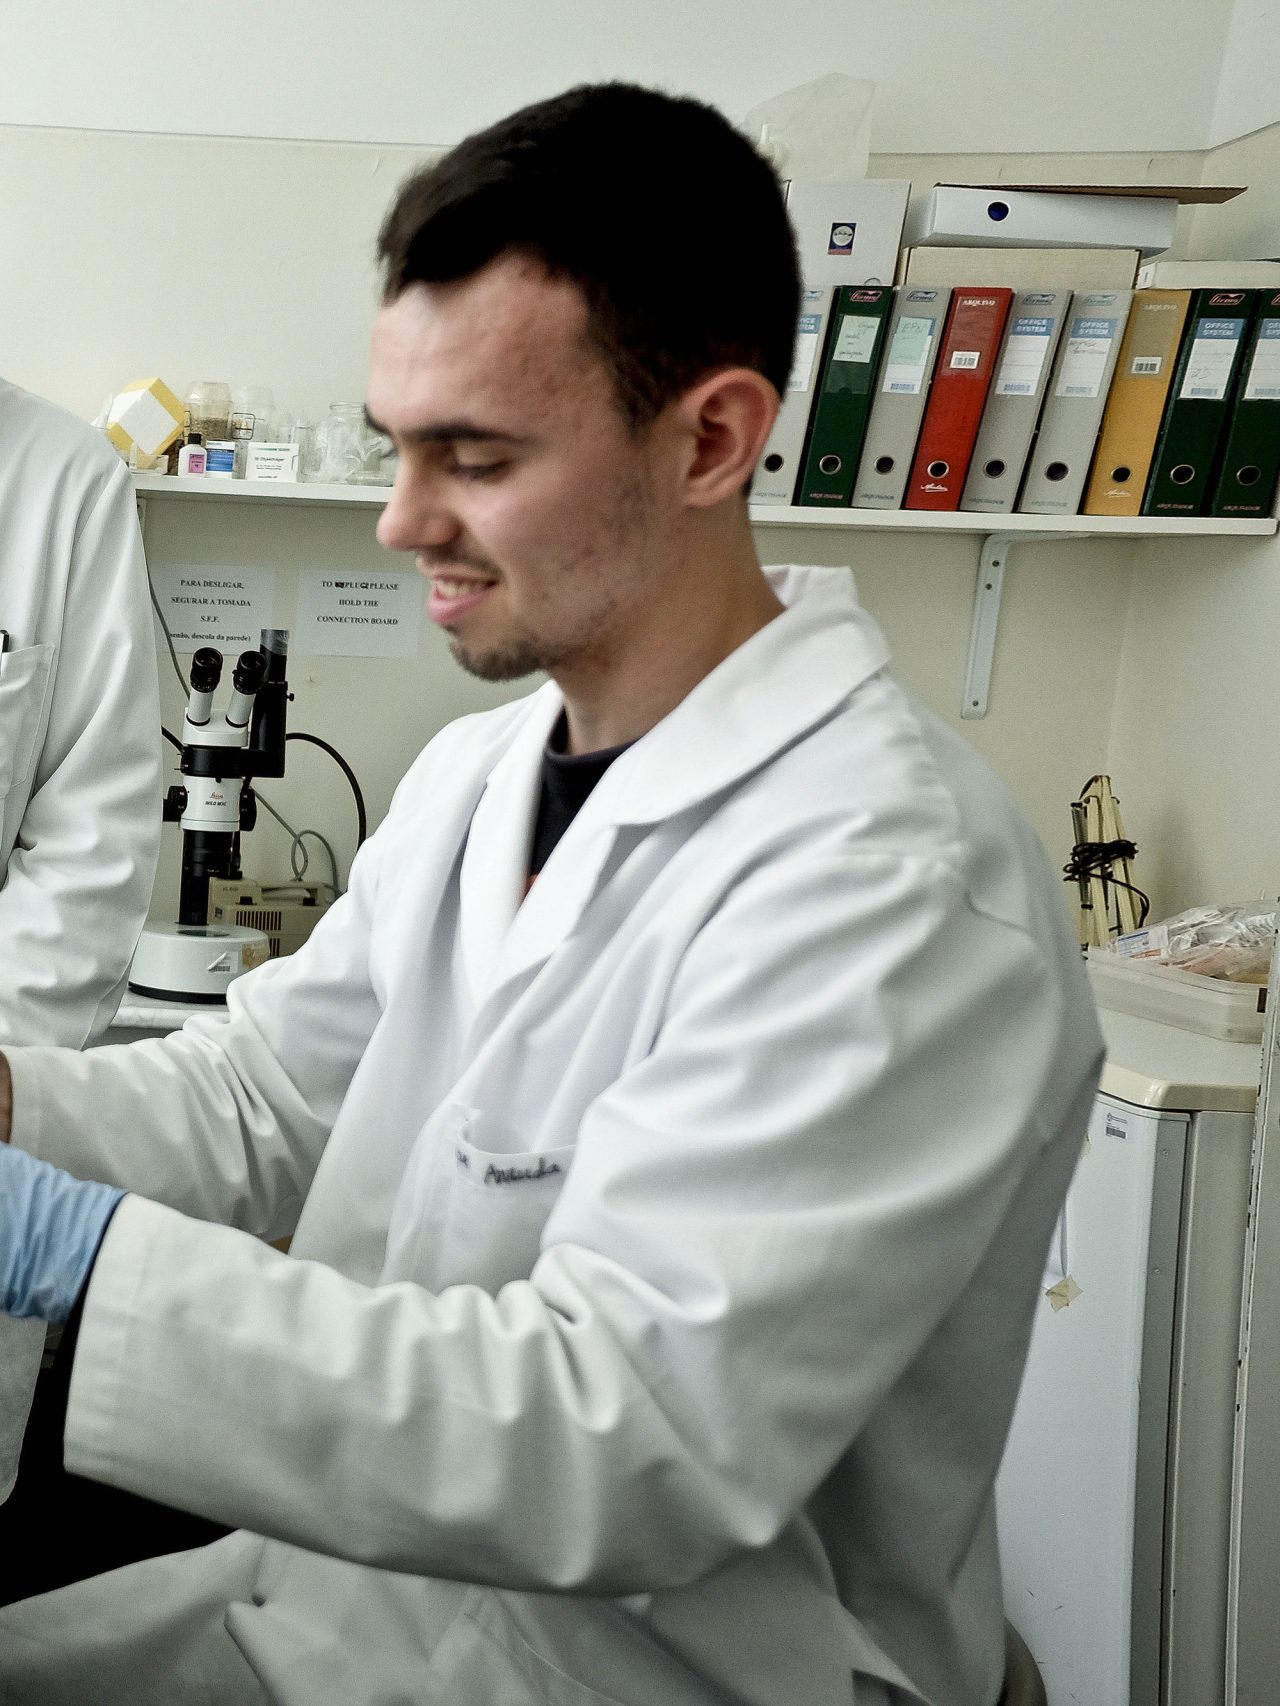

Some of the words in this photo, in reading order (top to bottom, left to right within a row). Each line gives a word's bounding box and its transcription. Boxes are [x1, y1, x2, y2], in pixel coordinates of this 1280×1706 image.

[180, 579, 201, 587] PARA
[171, 597, 208, 605] SEGURAR
[217, 599, 252, 607] TOMADA
[317, 615, 369, 624] CONNECTION
[370, 617, 399, 625] BOARD
[191, 632, 215, 640] descola
